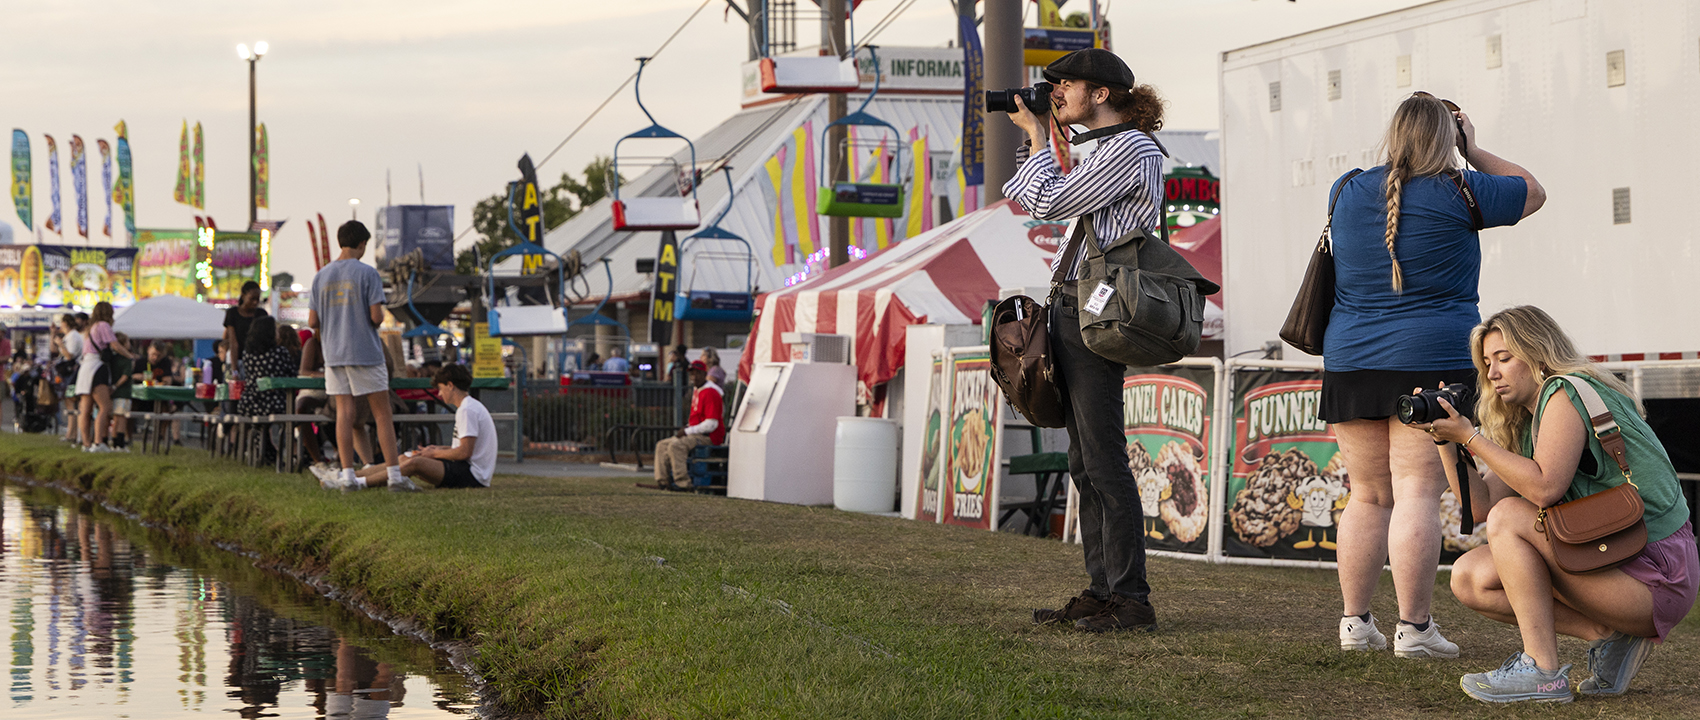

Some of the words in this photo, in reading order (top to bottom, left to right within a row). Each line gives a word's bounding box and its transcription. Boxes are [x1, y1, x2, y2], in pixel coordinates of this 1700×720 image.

[1463, 187, 1475, 208] Canon
[523, 182, 543, 275] ATM
[70, 249, 107, 265] BAKED
[653, 244, 677, 322] ATM
[62, 289, 115, 310] POTATO
[1123, 384, 1158, 426] NNEL
[1161, 384, 1203, 435] CAKES
[1249, 390, 1326, 438] FUNNEL
[953, 493, 983, 519] FRIES
[1537, 679, 1567, 693] HOKA
